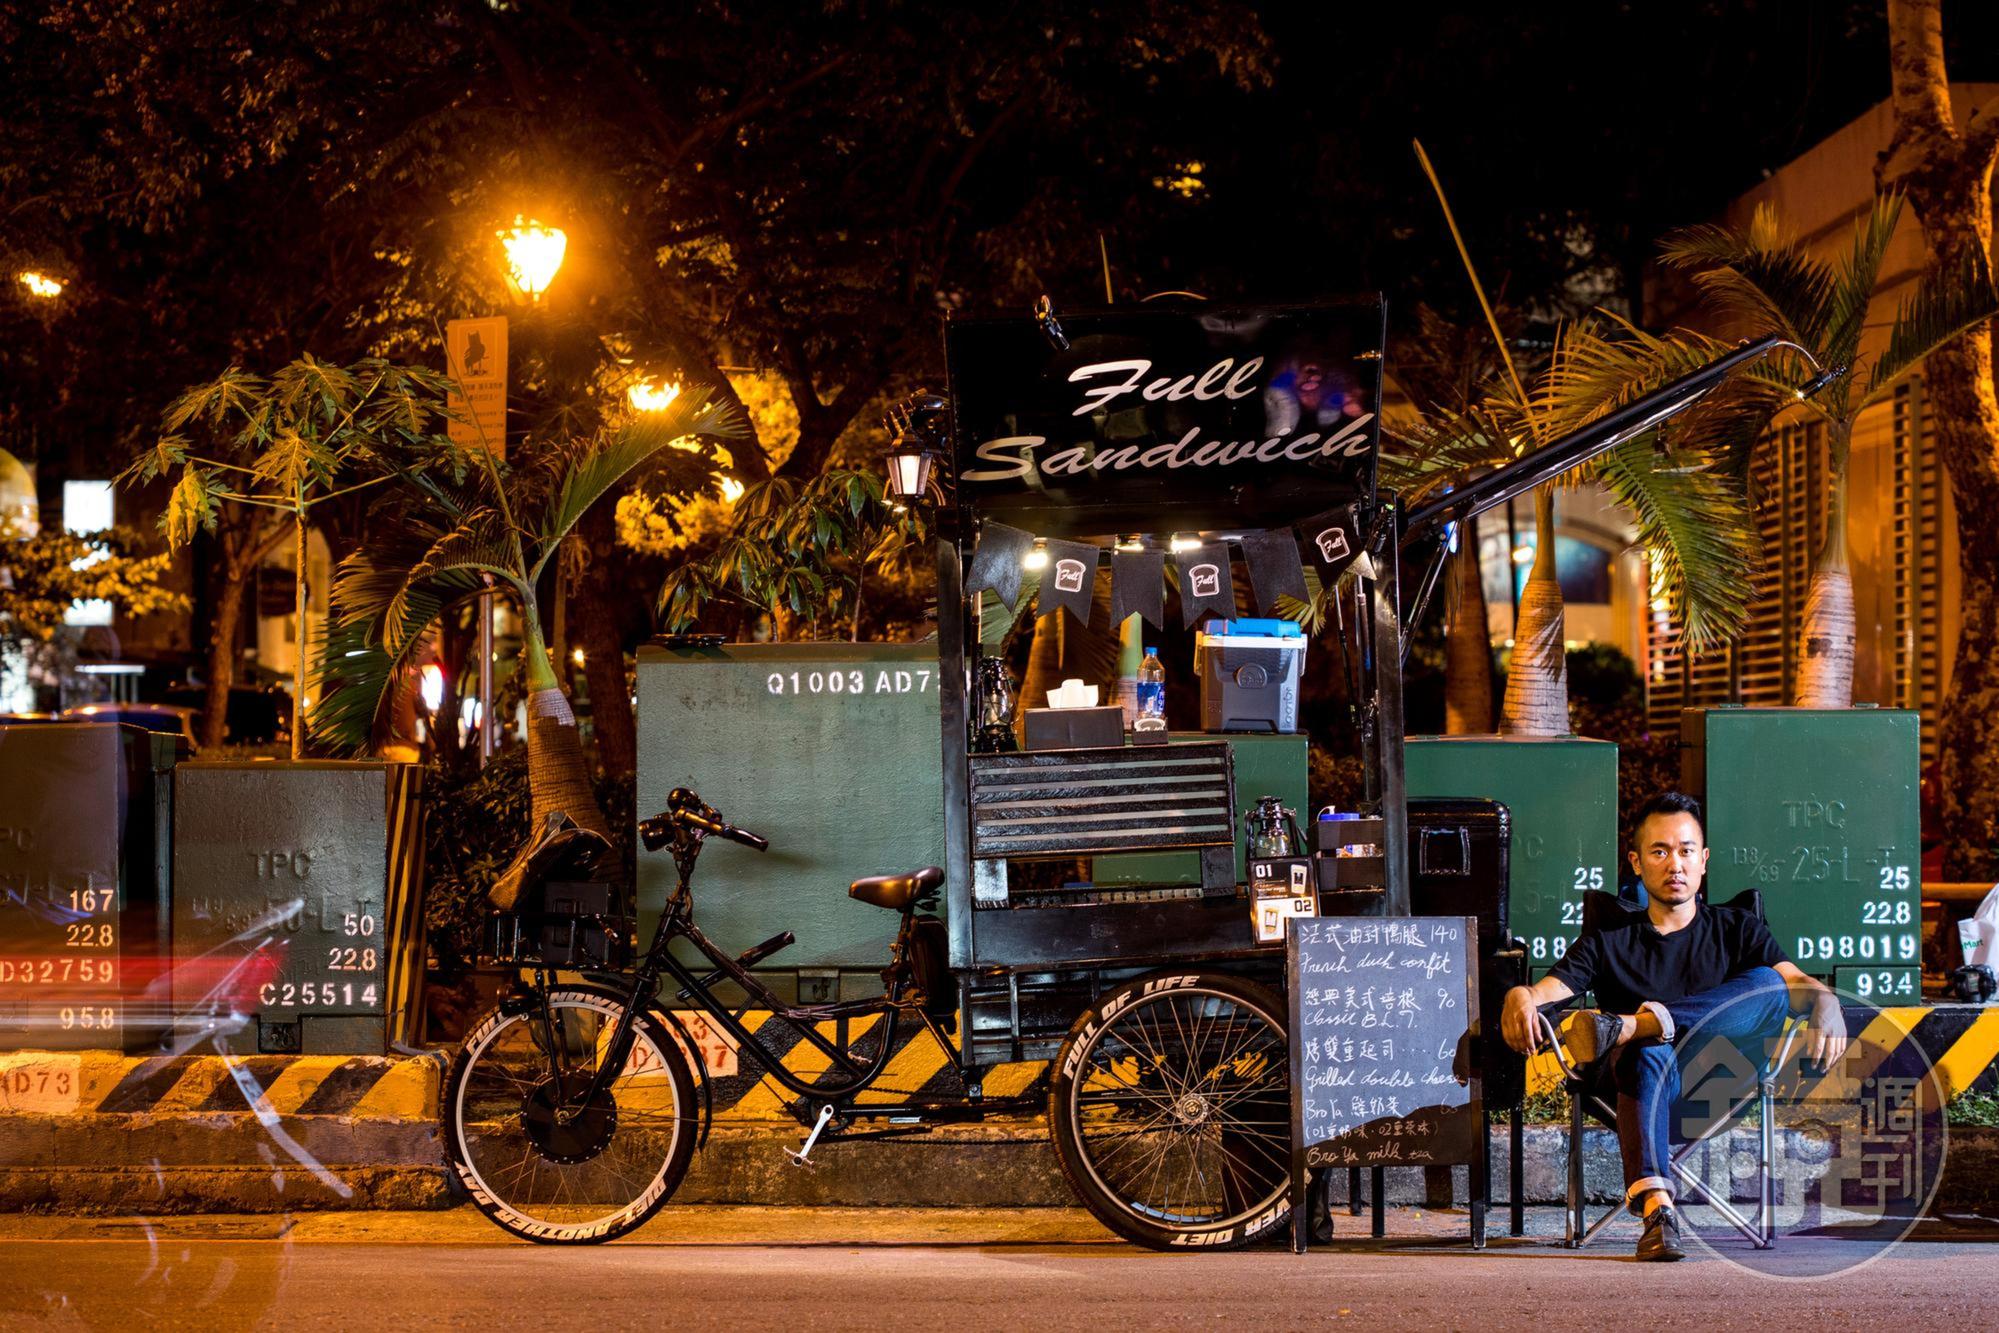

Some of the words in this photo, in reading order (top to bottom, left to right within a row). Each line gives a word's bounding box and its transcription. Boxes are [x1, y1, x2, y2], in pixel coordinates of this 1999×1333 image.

[1068, 356, 1264, 417] Full
[961, 413, 1375, 481] Sandwich
[1324, 536, 1342, 553] Full
[1060, 568, 1081, 582] Full
[1195, 574, 1215, 588] Full
[767, 671, 864, 695] Q1003
[875, 670, 941, 694] AD7
[1782, 799, 1846, 829] TPC
[1256, 864, 1272, 877] 01
[1574, 867, 1604, 890] 25
[1880, 866, 1910, 890] 25
[69, 889, 114, 913] 167
[1294, 900, 1312, 912] 02
[1863, 901, 1911, 925] 22.8
[66, 924, 114, 947] 22.8
[344, 914, 375, 937] 50
[1430, 924, 1457, 945] 140
[328, 947, 377, 971] 22.8
[1798, 936, 1916, 960] D98019
[0, 959, 113, 983] D32759
[1301, 952, 1351, 974] French
[1400, 951, 1452, 979] confit
[260, 982, 378, 1008] C25514
[1857, 972, 1913, 996] 93.4
[1437, 988, 1456, 1010] 90
[60, 1007, 115, 1030] 95.8
[1063, 1022, 1097, 1080] FULL
[1101, 990, 1131, 1021] OF
[1144, 975, 1200, 996] LIFE
[1438, 1038, 1456, 1059] 60
[1305, 1066, 1355, 1093] Grilled
[1361, 1069, 1415, 1088] double
[1367, 1141, 1403, 1160] milk
[454, 1161, 493, 1206] DAY
[496, 1208, 612, 1240] ANOTHER
[1245, 1197, 1291, 1236] VER
[1170, 1228, 1234, 1246] DIET
